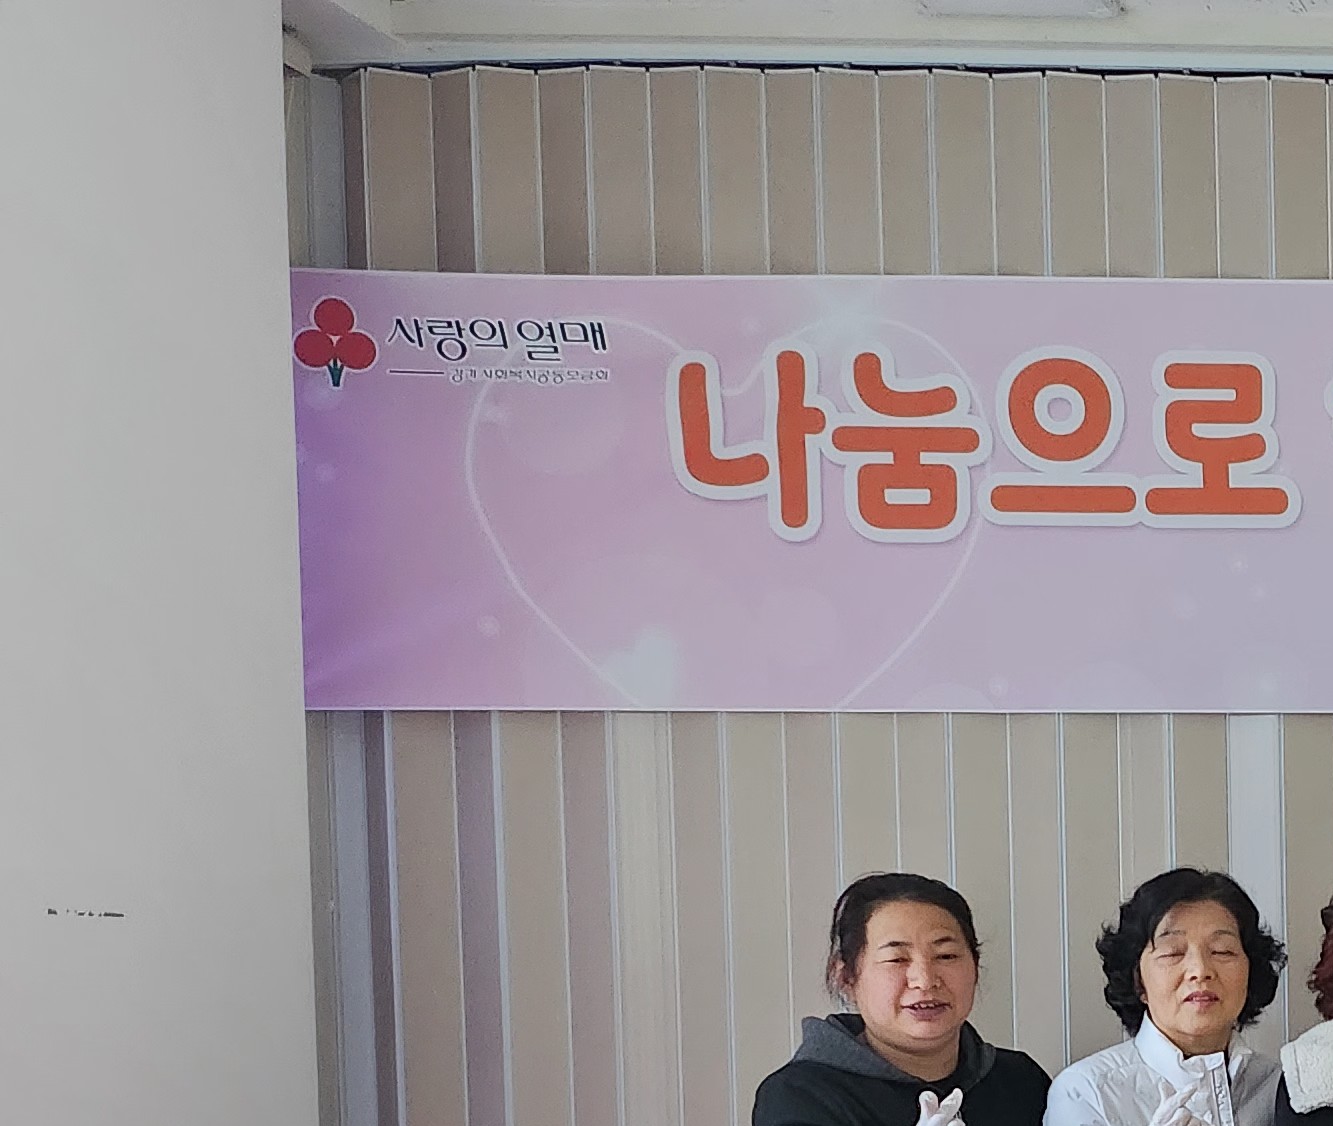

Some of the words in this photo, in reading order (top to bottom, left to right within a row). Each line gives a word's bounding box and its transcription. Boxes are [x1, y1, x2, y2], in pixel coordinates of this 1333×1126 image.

[388, 318, 509, 362] 사랑의
[516, 320, 608, 361] 열매
[676, 348, 1291, 532] 나눔으로
